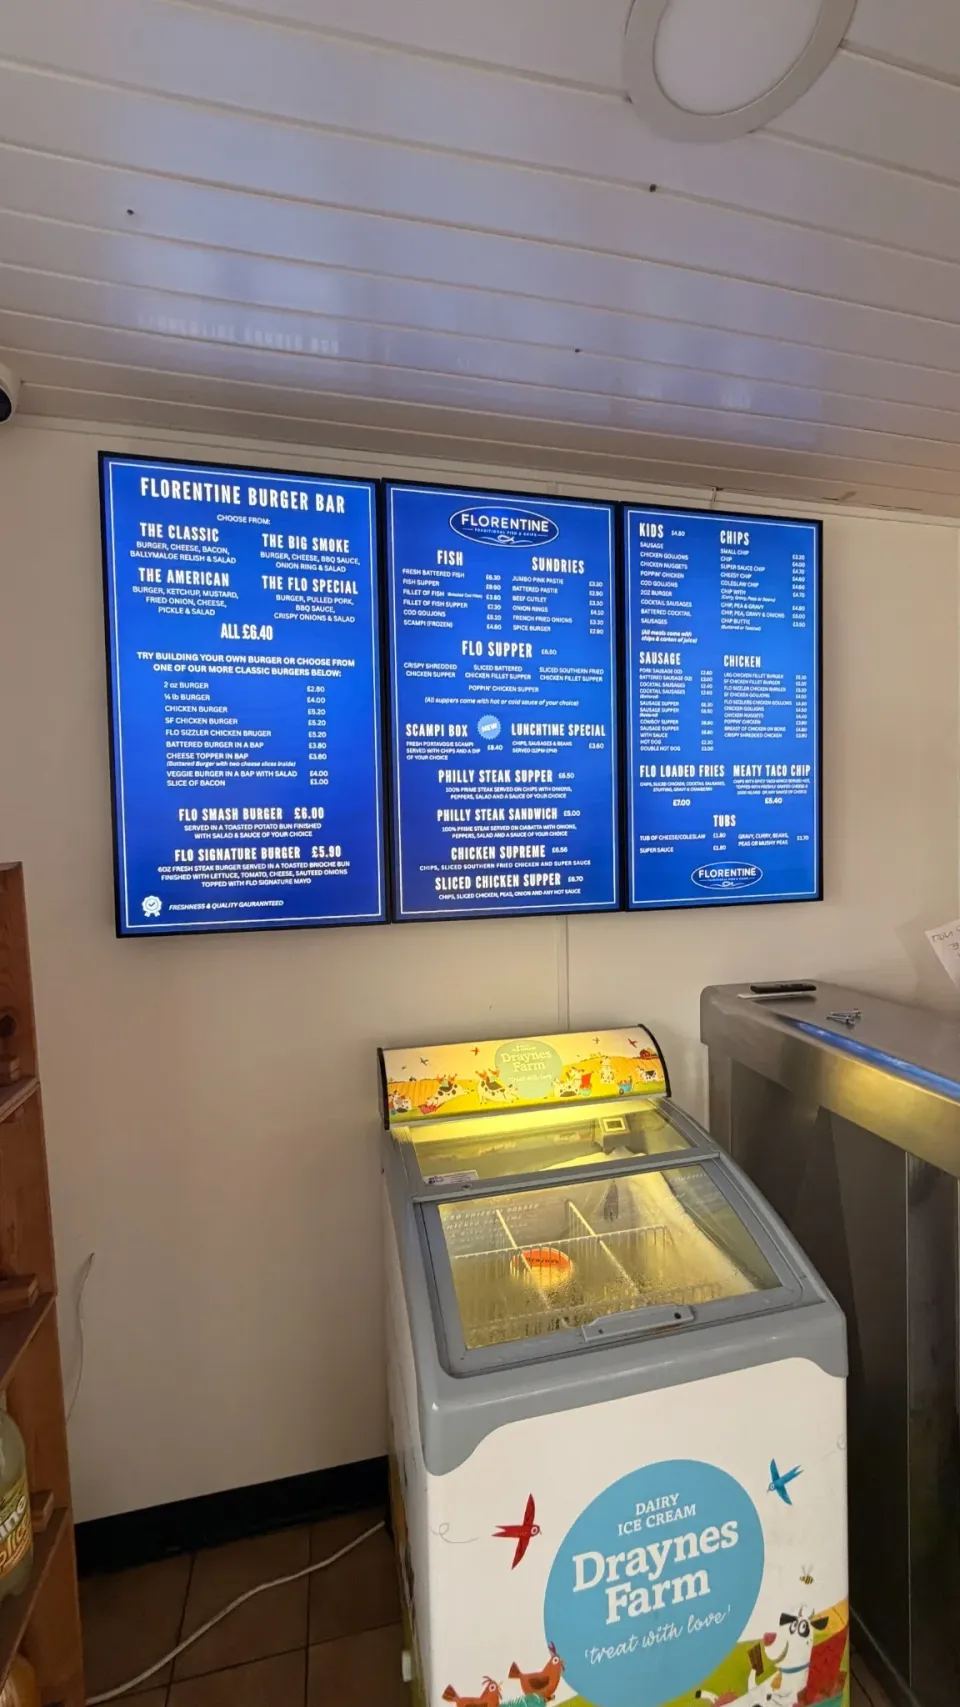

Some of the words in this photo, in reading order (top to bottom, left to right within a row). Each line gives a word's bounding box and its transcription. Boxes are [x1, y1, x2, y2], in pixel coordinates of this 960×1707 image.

[141, 478, 240, 504] FLORENTINE
[248, 487, 308, 510] BURGER
[316, 494, 344, 513] BAR
[217, 514, 247, 523] CHOOSE
[248, 517, 270, 525] FROM:
[461, 513, 549, 532] FLORENTINE
[140, 523, 163, 538] THE
[168, 525, 219, 542] CLASSIC
[640, 523, 663, 538] KIDS
[720, 530, 749, 545] CHIPS
[137, 541, 169, 551] BURGER,
[170, 544, 201, 553] CHEESE,
[202, 546, 229, 555] BACON,
[262, 534, 283, 548] THE
[288, 536, 307, 550] BIG
[312, 537, 349, 553] SMOKE
[130, 551, 178, 560] BALLYMALOE
[213, 556, 236, 564] SALAD
[260, 551, 290, 561] BURGER,
[292, 554, 320, 563] CHEESE,
[321, 556, 335, 564] BBQ
[337, 557, 360, 565] SAUCE,
[437, 550, 463, 566] FISH
[532, 557, 584, 574] SUNDRIES
[139, 568, 161, 583] THE
[167, 570, 229, 587] AMERICAN
[262, 575, 283, 590] THE
[288, 577, 307, 591] FLO
[312, 579, 358, 594] SPECIAL
[133, 586, 165, 595] BURGER,
[166, 588, 201, 597] KETCHUP,
[202, 590, 238, 599] MUSTARD,
[333, 615, 355, 623] SALAD
[221, 623, 240, 639] ALL
[242, 624, 273, 640] £6.40
[462, 640, 482, 656] FLO
[488, 642, 532, 658] SUPPER
[156, 652, 199, 661] BUILDING
[200, 654, 224, 662] YOUR
[225, 655, 246, 663] OWN
[248, 656, 282, 664] BURGER
[296, 658, 331, 666] CHOOSE
[640, 652, 680, 665] SAUSAGE
[724, 655, 760, 668] CHICKEN
[174, 664, 186, 672] OF
[235, 666, 270, 675] CLASSIC
[271, 668, 310, 676] BURGERS
[406, 724, 444, 736] SCAMPI
[449, 724, 468, 737] BOX
[512, 723, 564, 736] LUNCHTIME
[568, 724, 605, 736] SPECIAL
[439, 770, 474, 783] PHILLY
[479, 770, 511, 783] STEAK
[515, 770, 552, 783] SUPPER
[640, 765, 656, 777] FLO
[661, 765, 695, 777] LOADED
[699, 765, 724, 777] FRIES
[733, 765, 762, 777] MEATY
[765, 765, 787, 776] TACO
[791, 765, 810, 776] CHIP
[179, 809, 198, 821] FLO
[202, 808, 238, 821] SMASH
[243, 808, 282, 820] BURGER
[294, 807, 324, 819] £6.00
[437, 809, 471, 821] PHILLY
[475, 808, 505, 821] STEAK
[509, 808, 557, 820] SANDWICH
[713, 815, 736, 827] TUBS
[175, 849, 193, 862] FLO
[198, 848, 257, 861] SIGNATURE
[261, 847, 300, 860] BURGER
[312, 846, 341, 858] £5.90
[451, 846, 495, 860] CHICKEN
[500, 845, 545, 859] SUPREME
[698, 867, 756, 878] FLORENTINE
[435, 876, 471, 890] SLICED
[476, 874, 519, 888] CHICKEN
[523, 873, 561, 887] SUPPER
[211, 902, 238, 910] QUALITY
[500, 1051, 552, 1062] Draynes
[513, 1062, 546, 1072] Farm
[635, 1493, 680, 1515] DAIRY
[617, 1518, 641, 1536] ICE
[646, 1504, 696, 1529] CREAM
[572, 1520, 739, 1593] Draynes
[605, 1570, 710, 1625] Farm
[641, 1622, 682, 1649] with
